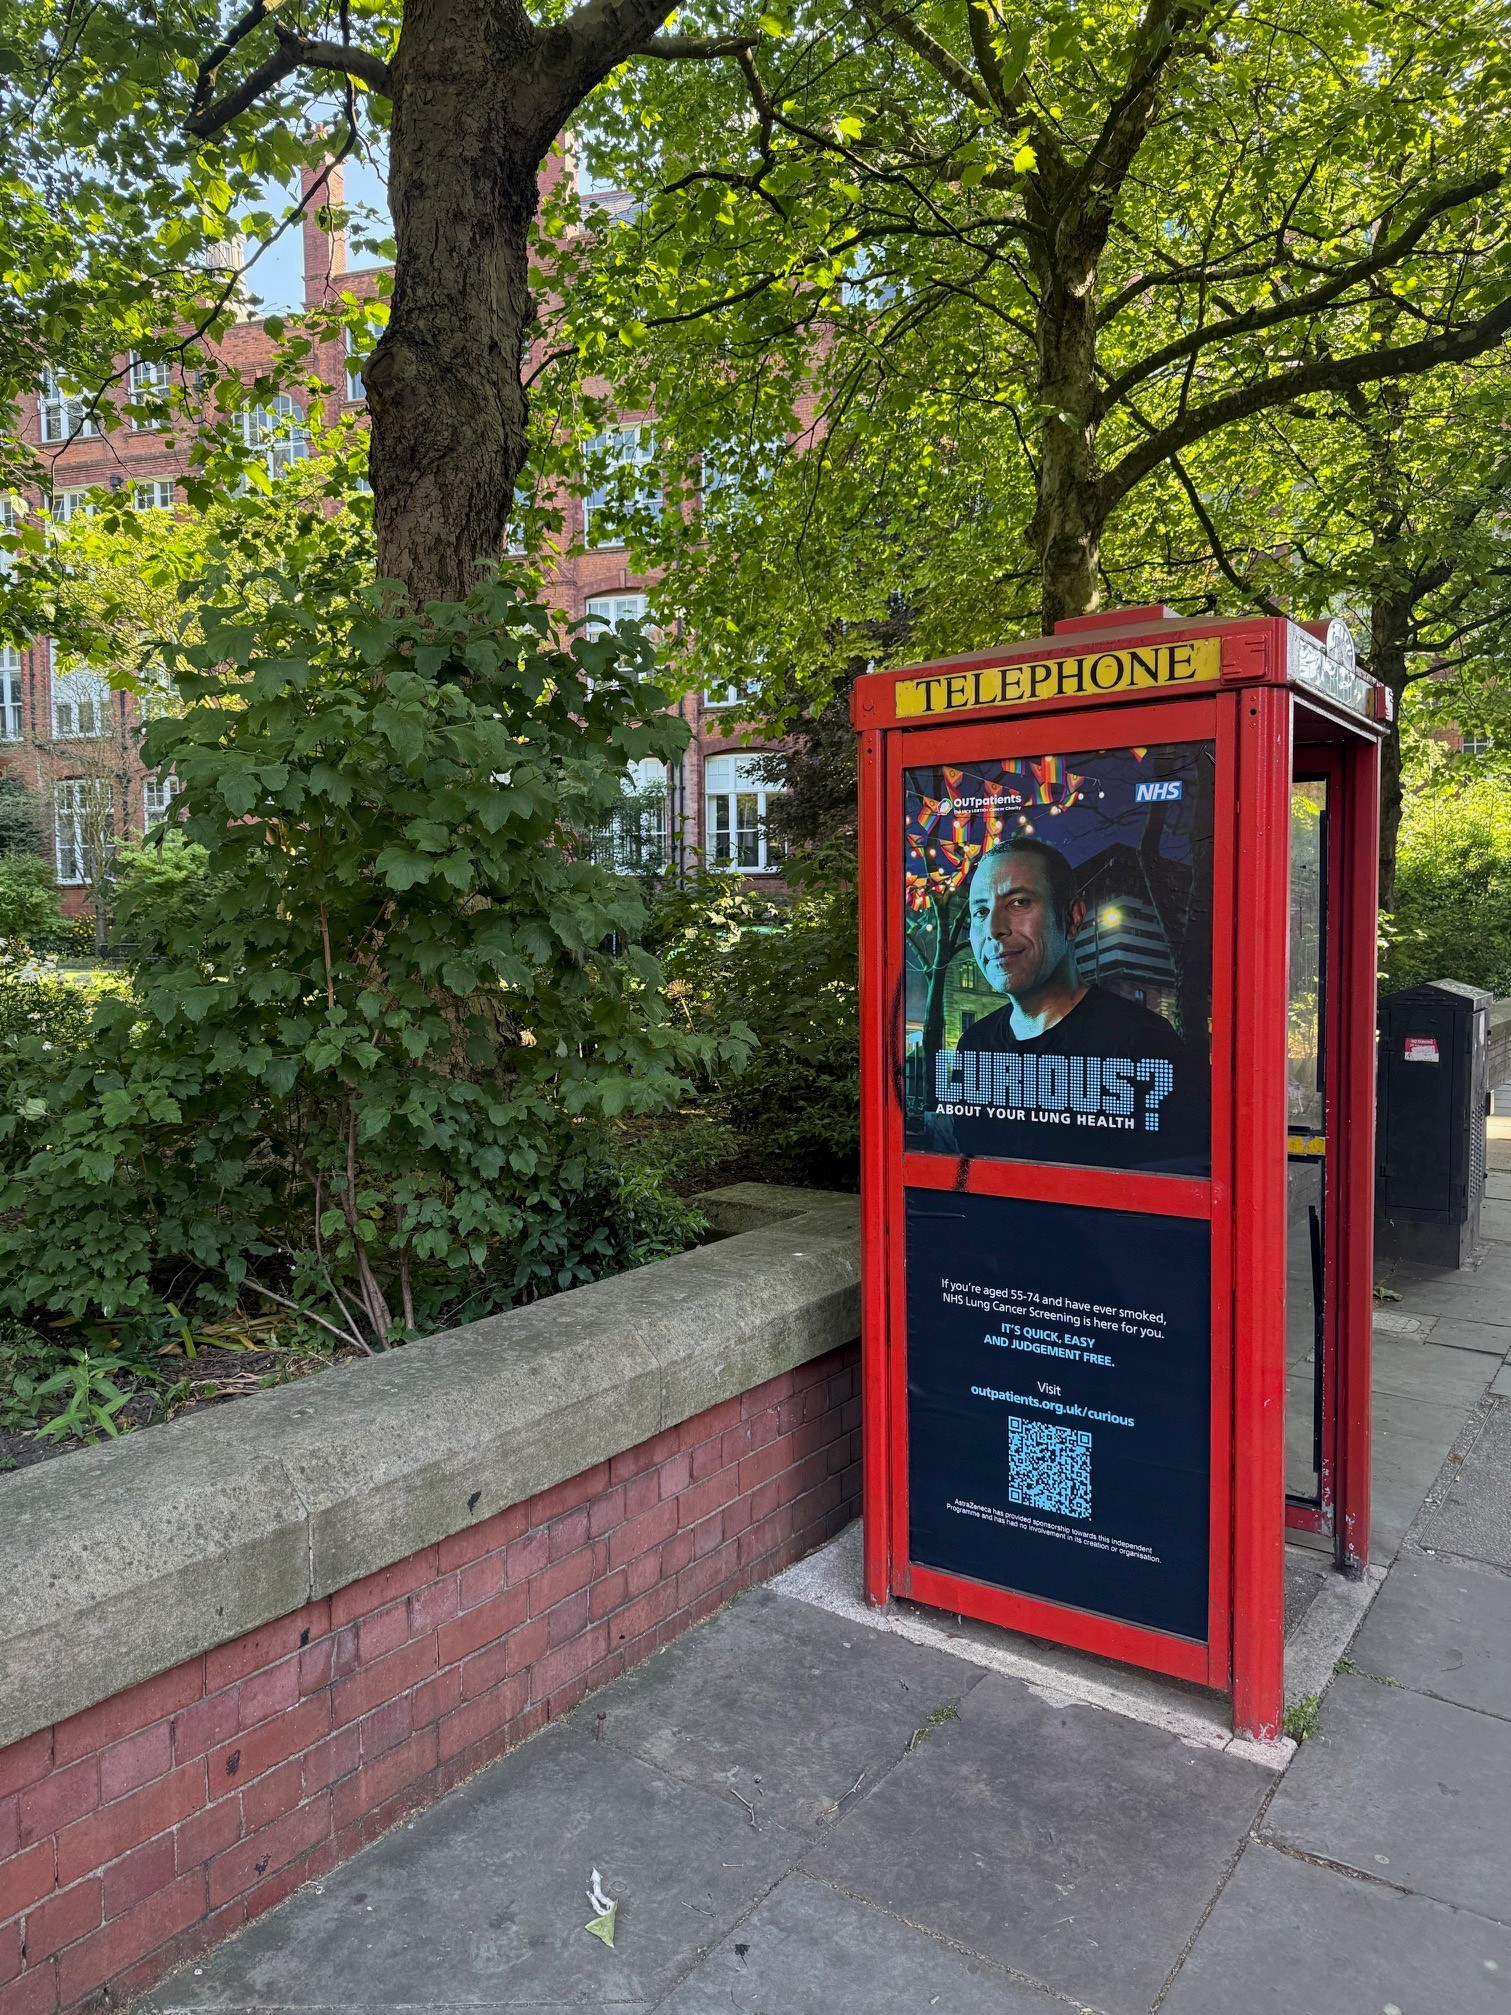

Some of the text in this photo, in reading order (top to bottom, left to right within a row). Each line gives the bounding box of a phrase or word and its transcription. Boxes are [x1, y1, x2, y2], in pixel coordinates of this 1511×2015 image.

[916, 644, 1197, 712] TELEPHONE
[954, 794, 1022, 808] OUTpatients
[1136, 782, 1180, 800] NHS
[935, 1050, 1174, 1131] CURIOUS?
[936, 1104, 1135, 1130] ABOUT YOUR LUNG HEALTH
[942, 1279, 1167, 1326] If you're aged 55-74 and have ever smoked,
[943, 1293, 1164, 1338] NHS Lung Cancer Screening is here for you.
[984, 1334, 1115, 1367] AND JUDGEMENT FREE.
[1001, 1323, 1095, 1348] IT'S QUICK, EASY
[970, 1385, 1135, 1427] outpatients.org.uk/curious
[1037, 1381, 1061, 1396] Visit
[946, 1503, 980, 1517] Programme
[981, 1512, 992, 1520] and
[994, 1516, 1005, 1524] has
[1006, 1519, 1018, 1527] had
[1029, 1524, 1065, 1540] involvement
[1083, 1539, 1109, 1551] creation
[1119, 1548, 1162, 1564] organisation.
[954, 1498, 1152, 1554] AstraZeneca has provided sponsorship towards this independent
